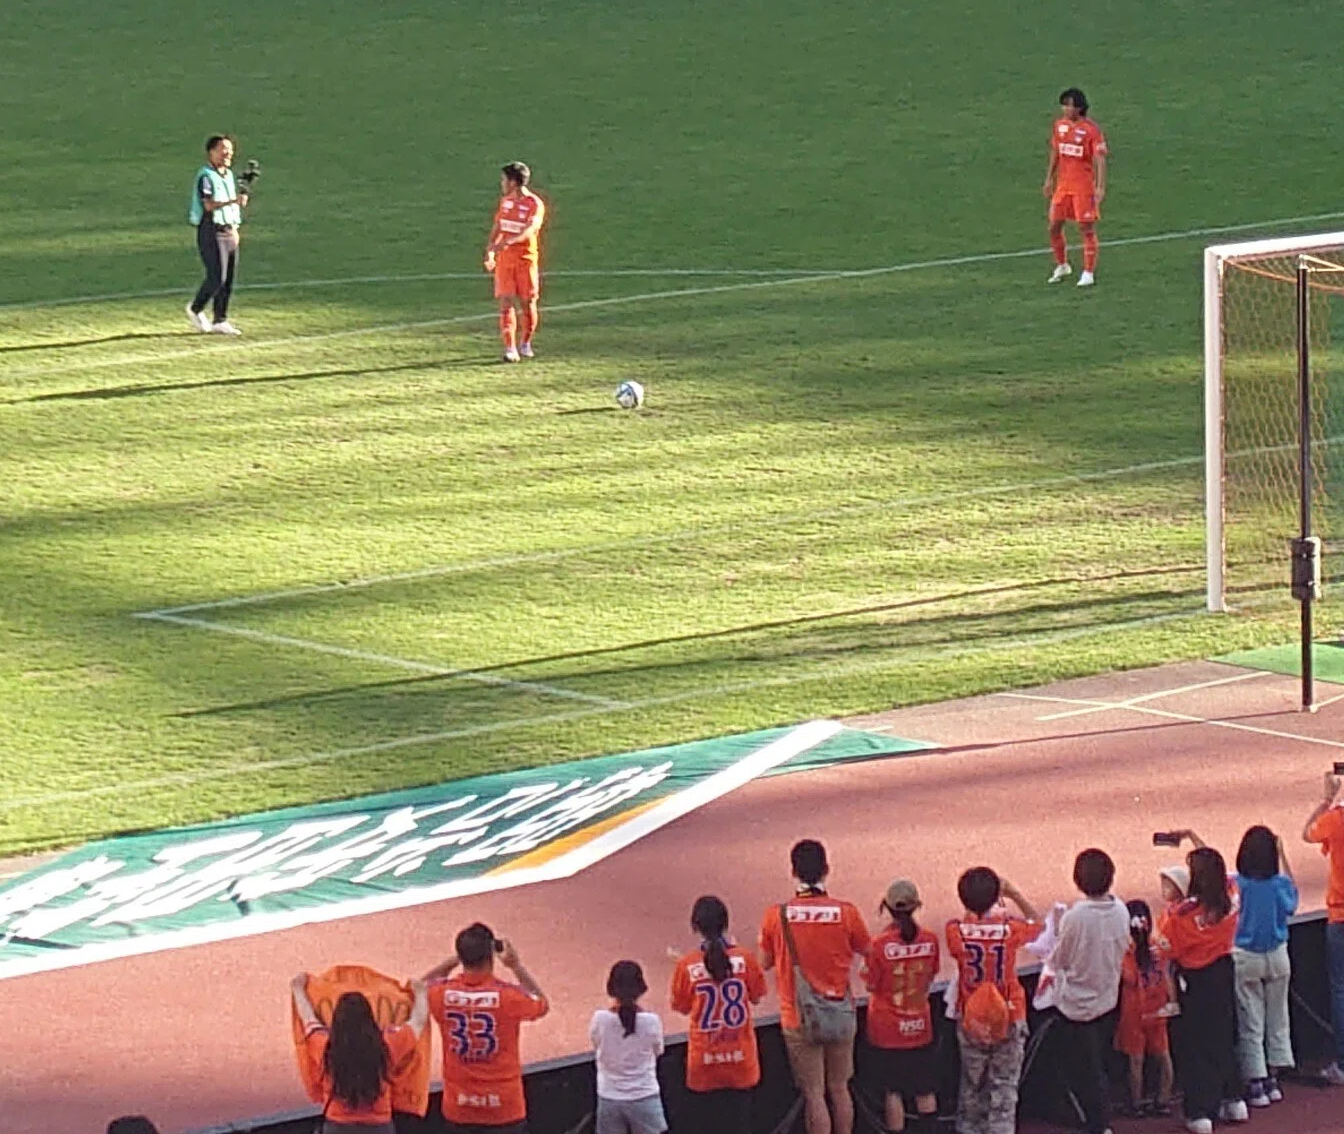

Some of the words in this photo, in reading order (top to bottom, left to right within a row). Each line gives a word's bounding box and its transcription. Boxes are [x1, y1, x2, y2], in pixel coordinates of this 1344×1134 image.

[963, 941, 1006, 985] 31
[695, 977, 746, 1033] 28
[444, 1011, 498, 1058] 33
